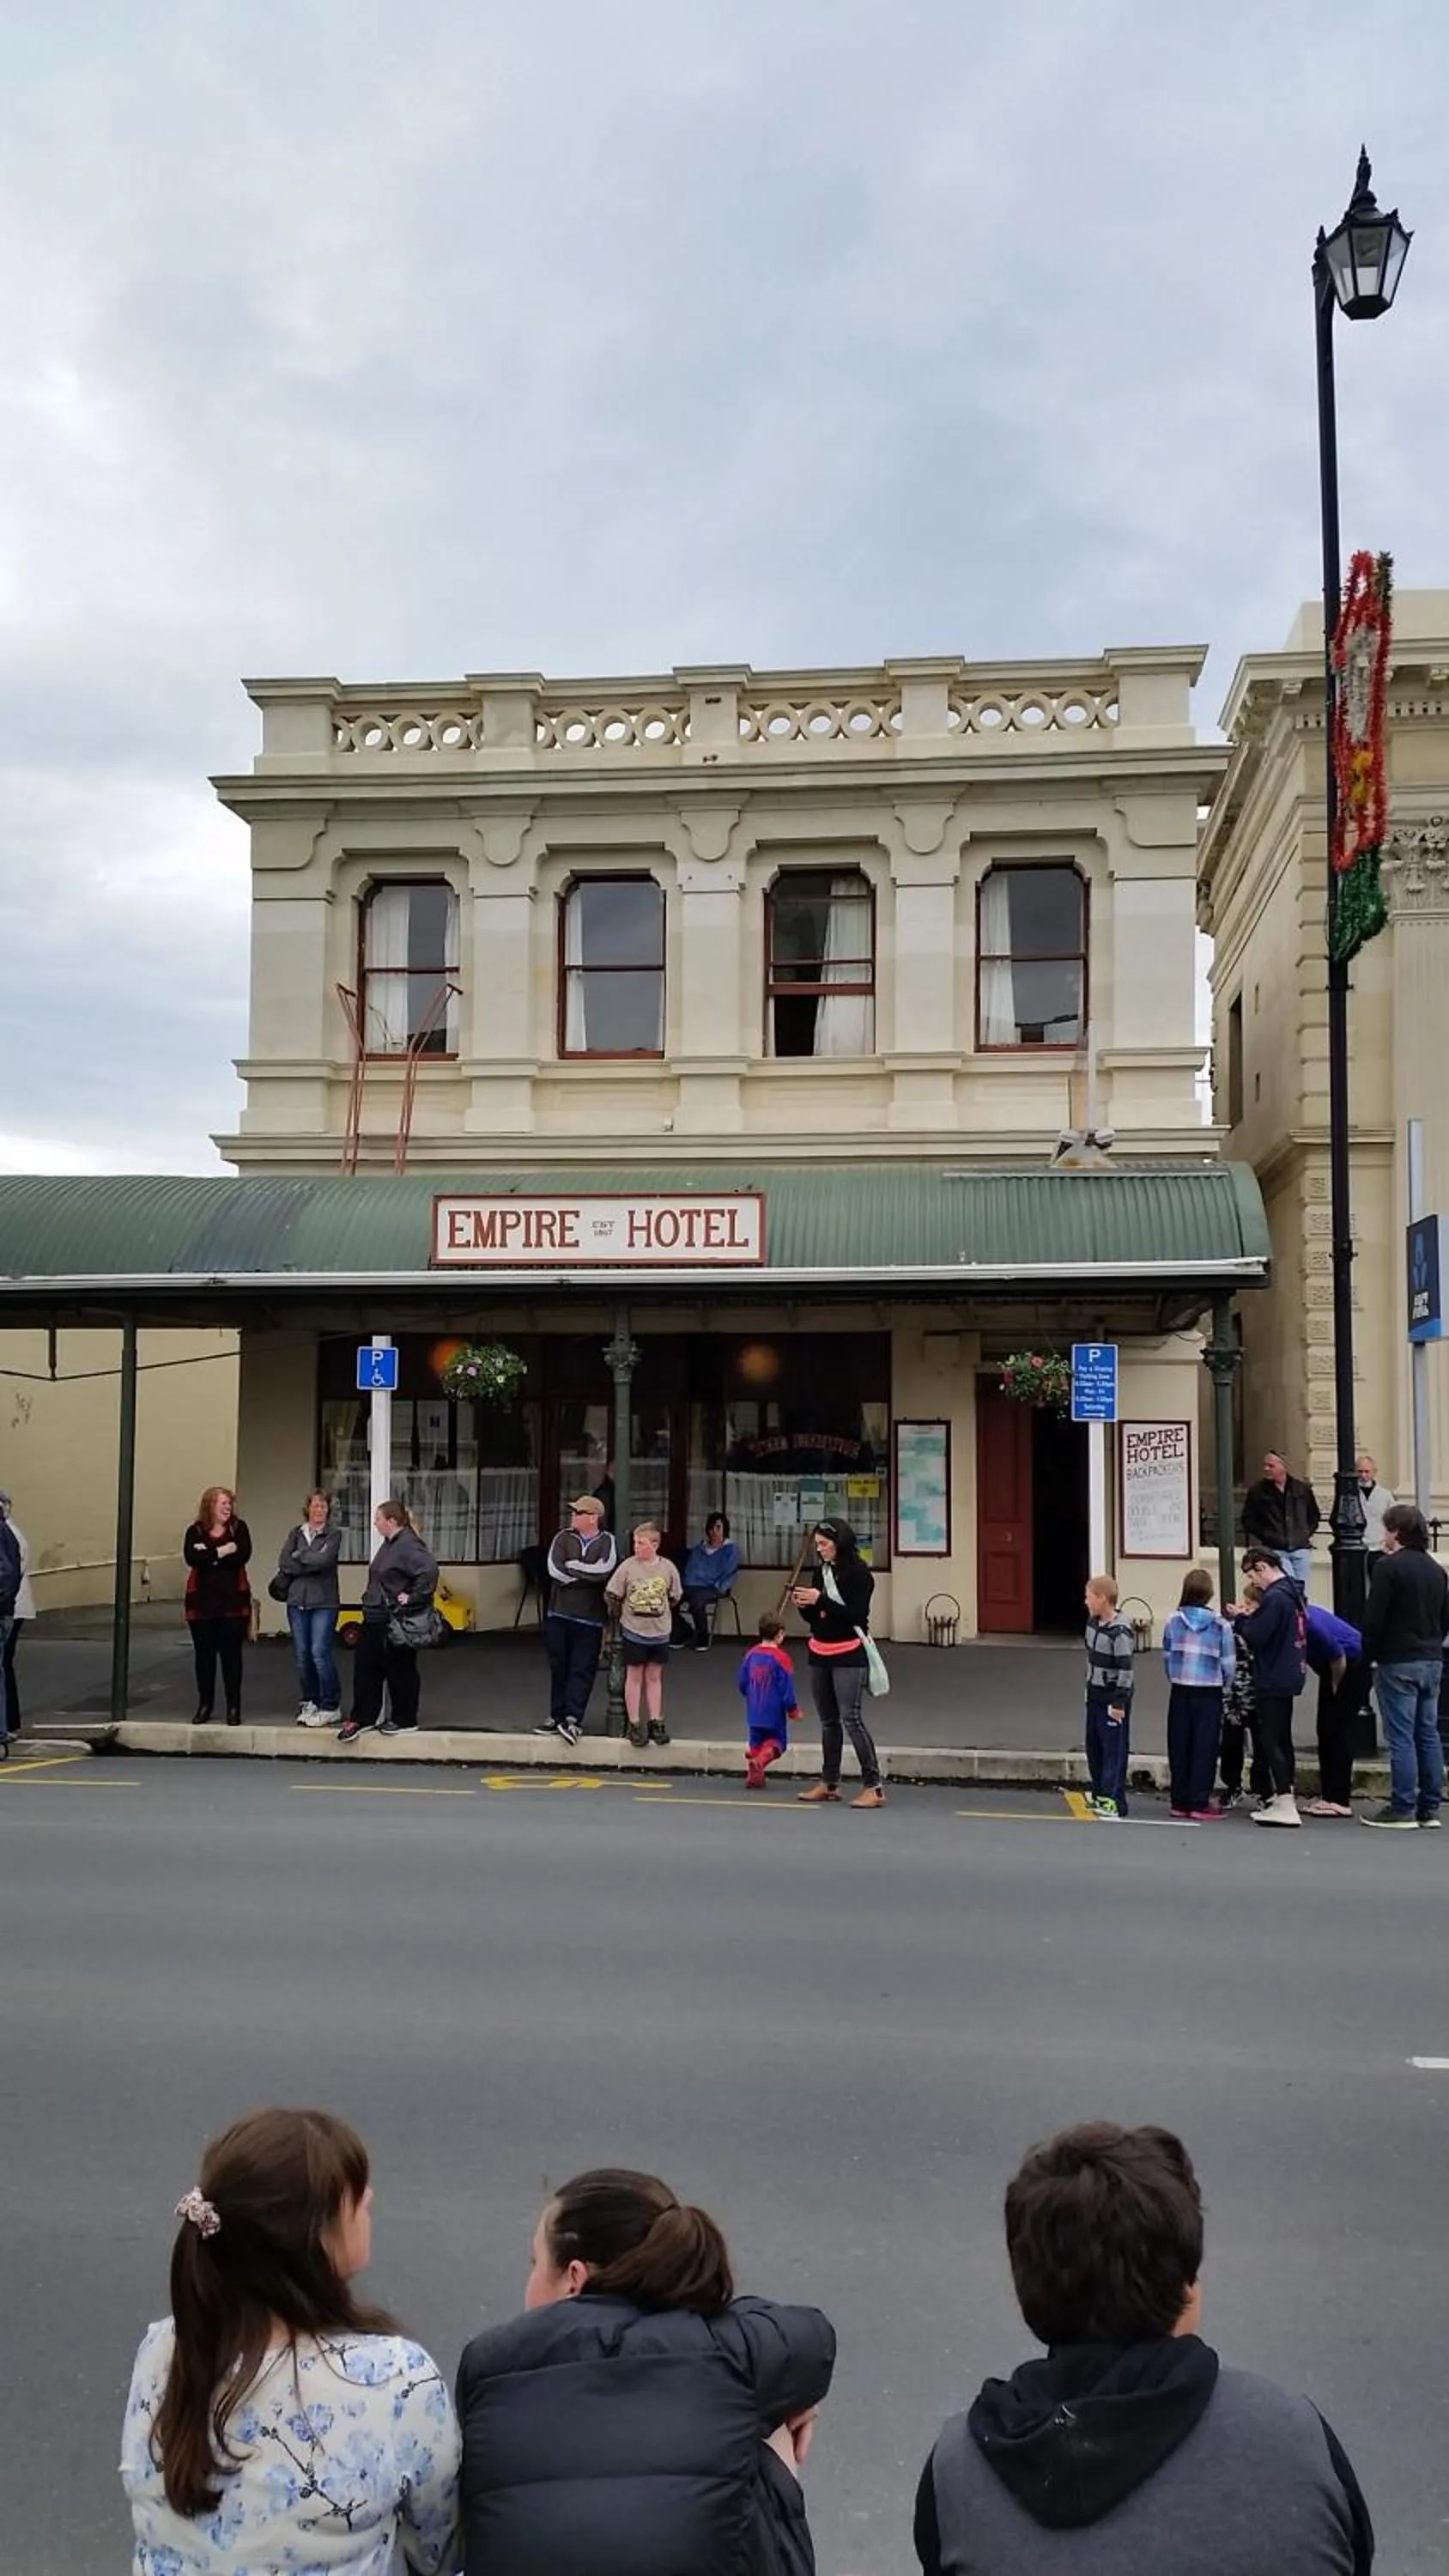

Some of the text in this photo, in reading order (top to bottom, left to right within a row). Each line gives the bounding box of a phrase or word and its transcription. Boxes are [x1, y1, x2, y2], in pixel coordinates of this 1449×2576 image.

[447, 1209, 749, 1249] EMPIRE HOTEL
[372, 1351, 384, 1365] P
[1088, 1349, 1101, 1363] P
[1126, 1427, 1184, 1449] EMPIRE
[1126, 1444, 1184, 1463] HOTEL
